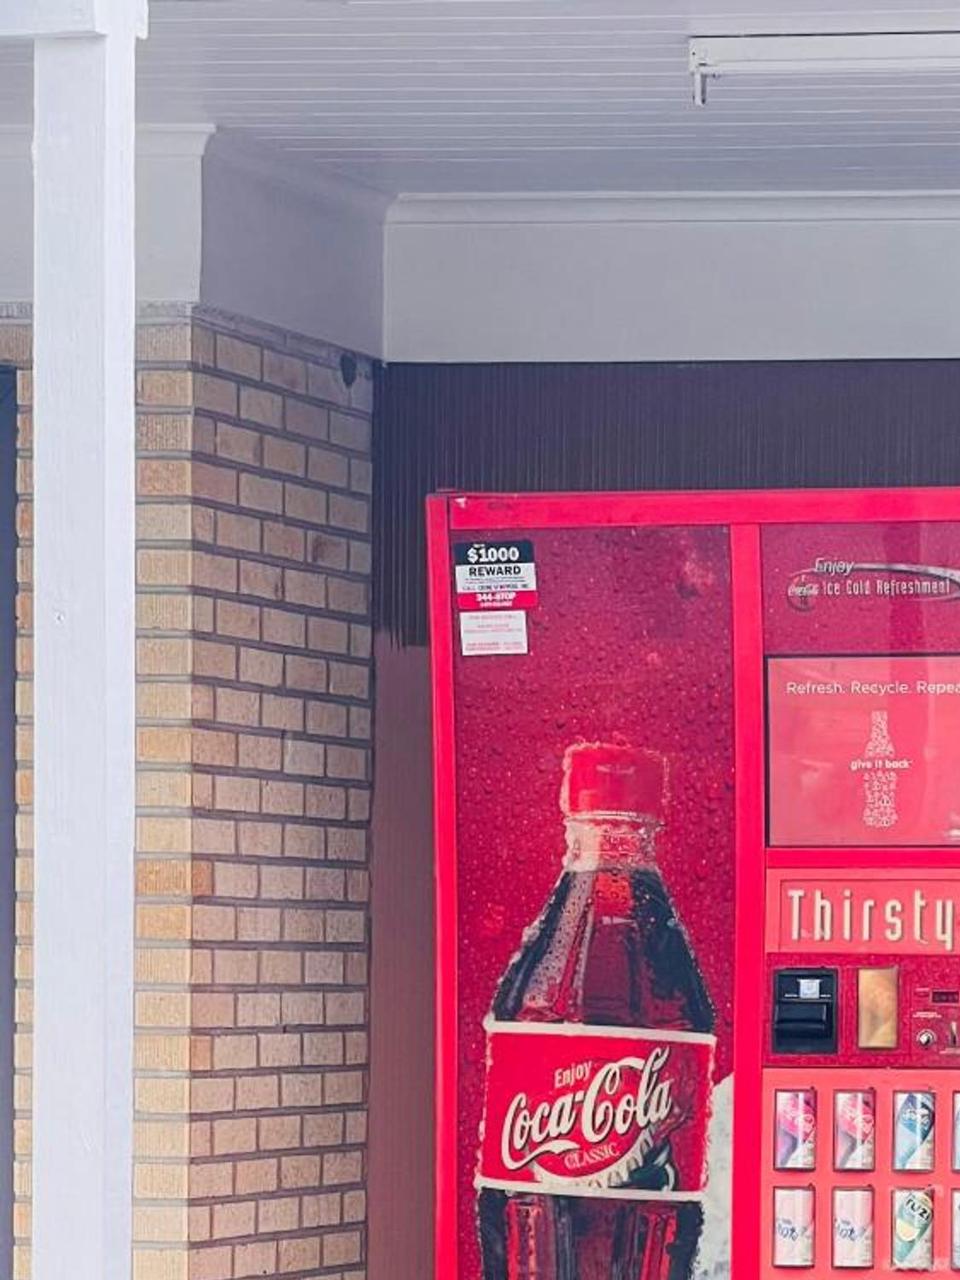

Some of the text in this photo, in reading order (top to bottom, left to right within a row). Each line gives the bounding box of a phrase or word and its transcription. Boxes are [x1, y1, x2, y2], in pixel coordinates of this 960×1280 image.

[467, 547, 519, 563] $1000
[468, 566, 521, 577] REWARD
[815, 558, 855, 575] Enjoy
[846, 580, 871, 595] Cold
[876, 579, 950, 596] Refreshment
[786, 681, 846, 695] Refresh.
[850, 759, 871, 771] give
[554, 1060, 593, 1088] Enjoy
[501, 1045, 675, 1170] Coca-Cola
[563, 1142, 621, 1170] CLASSIC
